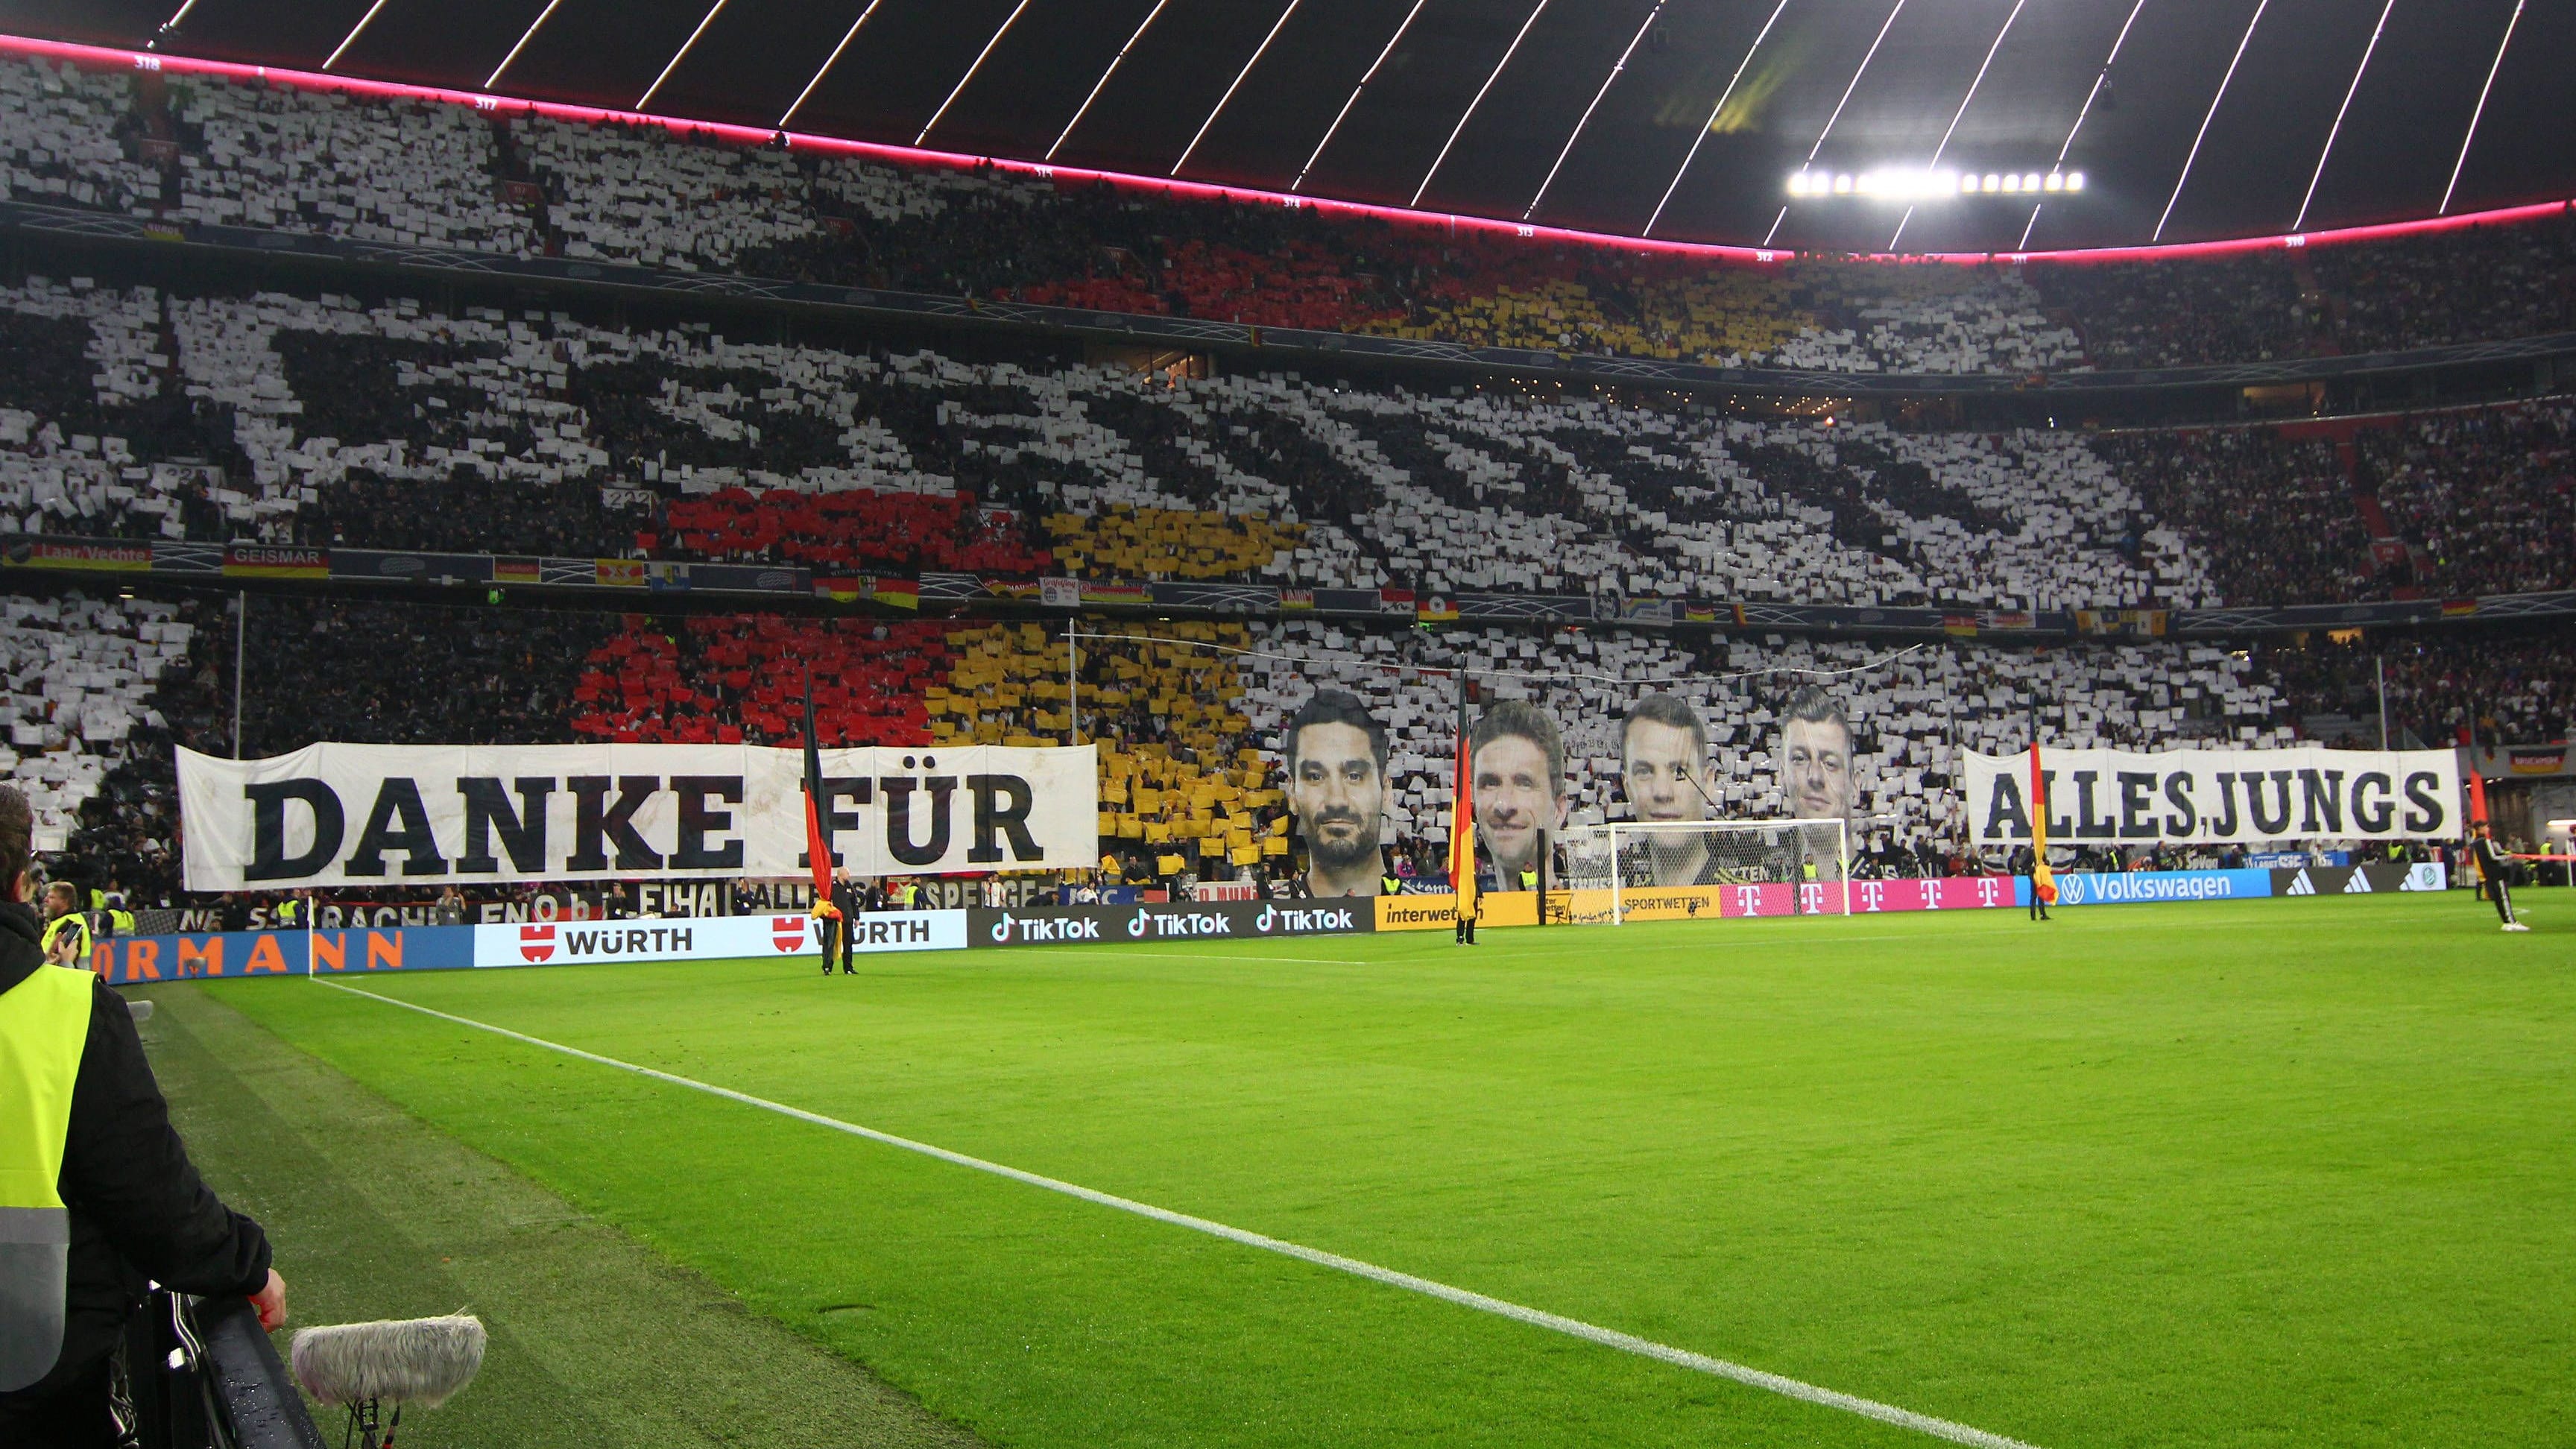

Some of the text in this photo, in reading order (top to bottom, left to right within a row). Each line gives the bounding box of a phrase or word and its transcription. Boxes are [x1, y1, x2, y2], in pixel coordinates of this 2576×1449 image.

[134, 56, 161, 71] 318
[475, 96, 497, 110] 317
[1516, 226, 1534, 237] 313
[2285, 236, 2305, 247] 310
[1756, 251, 1773, 262] 312
[233, 548, 320, 564] GEISMAR
[244, 755, 1044, 881] DANKE FÜR
[2091, 872, 2232, 900] Volkswagen
[1623, 896, 1710, 910] SPORTWETTEN
[1019, 916, 1099, 941] TikTok
[1154, 913, 1231, 937] TikTok
[1281, 909, 1353, 931] TikTok
[565, 926, 693, 956] WÜRTH
[91, 931, 404, 983] ÖRMANN
